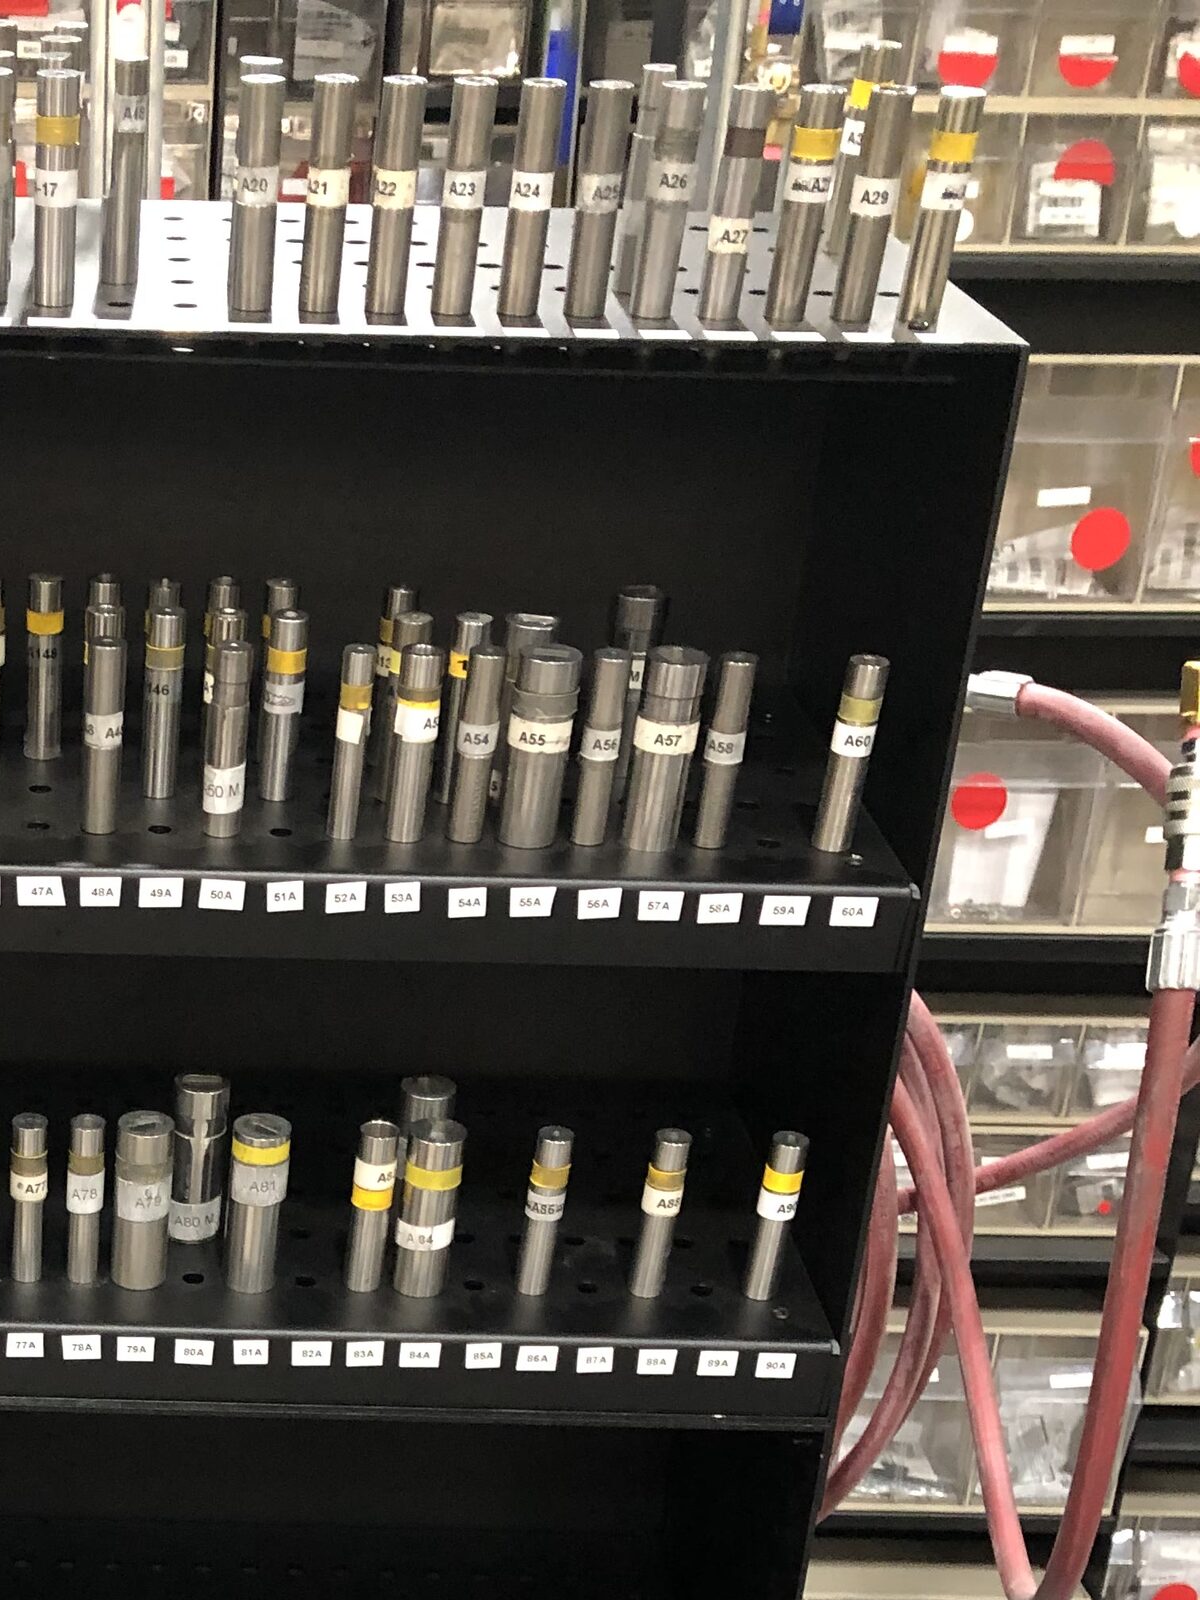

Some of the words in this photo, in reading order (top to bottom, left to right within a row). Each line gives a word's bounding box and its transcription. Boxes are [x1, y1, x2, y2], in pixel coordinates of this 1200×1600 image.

[659, 173, 687, 188] A26
[242, 179, 268, 193] A20
[449, 181, 476, 196] A23
[514, 182, 540, 198] A24
[860, 189, 889, 205] A29
[722, 229, 748, 244] A27
[463, 732, 489, 746] A54
[519, 731, 546, 746] A55
[654, 733, 682, 747] A57
[844, 733, 870, 748] A60
[31, 887, 53, 896] 47A
[91, 888, 114, 897] 48A
[150, 888, 172, 898] 49A
[210, 890, 232, 900] 50A
[274, 891, 296, 902] 51A
[334, 893, 357, 903] 52A
[391, 893, 413, 903] 53A
[458, 898, 481, 908] 54A
[519, 897, 541, 907] 55A
[587, 899, 609, 909] 56A
[647, 901, 669, 910] 57A
[773, 906, 795, 915] 59A
[841, 907, 863, 917] 60A
[249, 1180, 276, 1193] A81
[71, 1188, 98, 1200] A78
[174, 1215, 200, 1228] A80
[16, 1341, 36, 1349] 77A
[72, 1343, 93, 1351] 78A
[127, 1345, 147, 1353] 79A
[184, 1348, 204, 1356] 80A
[241, 1348, 262, 1356] 81A
[302, 1350, 322, 1358] 82A
[354, 1350, 374, 1358] 83A
[527, 1354, 548, 1362] 86A
[707, 1359, 728, 1367] 89A
